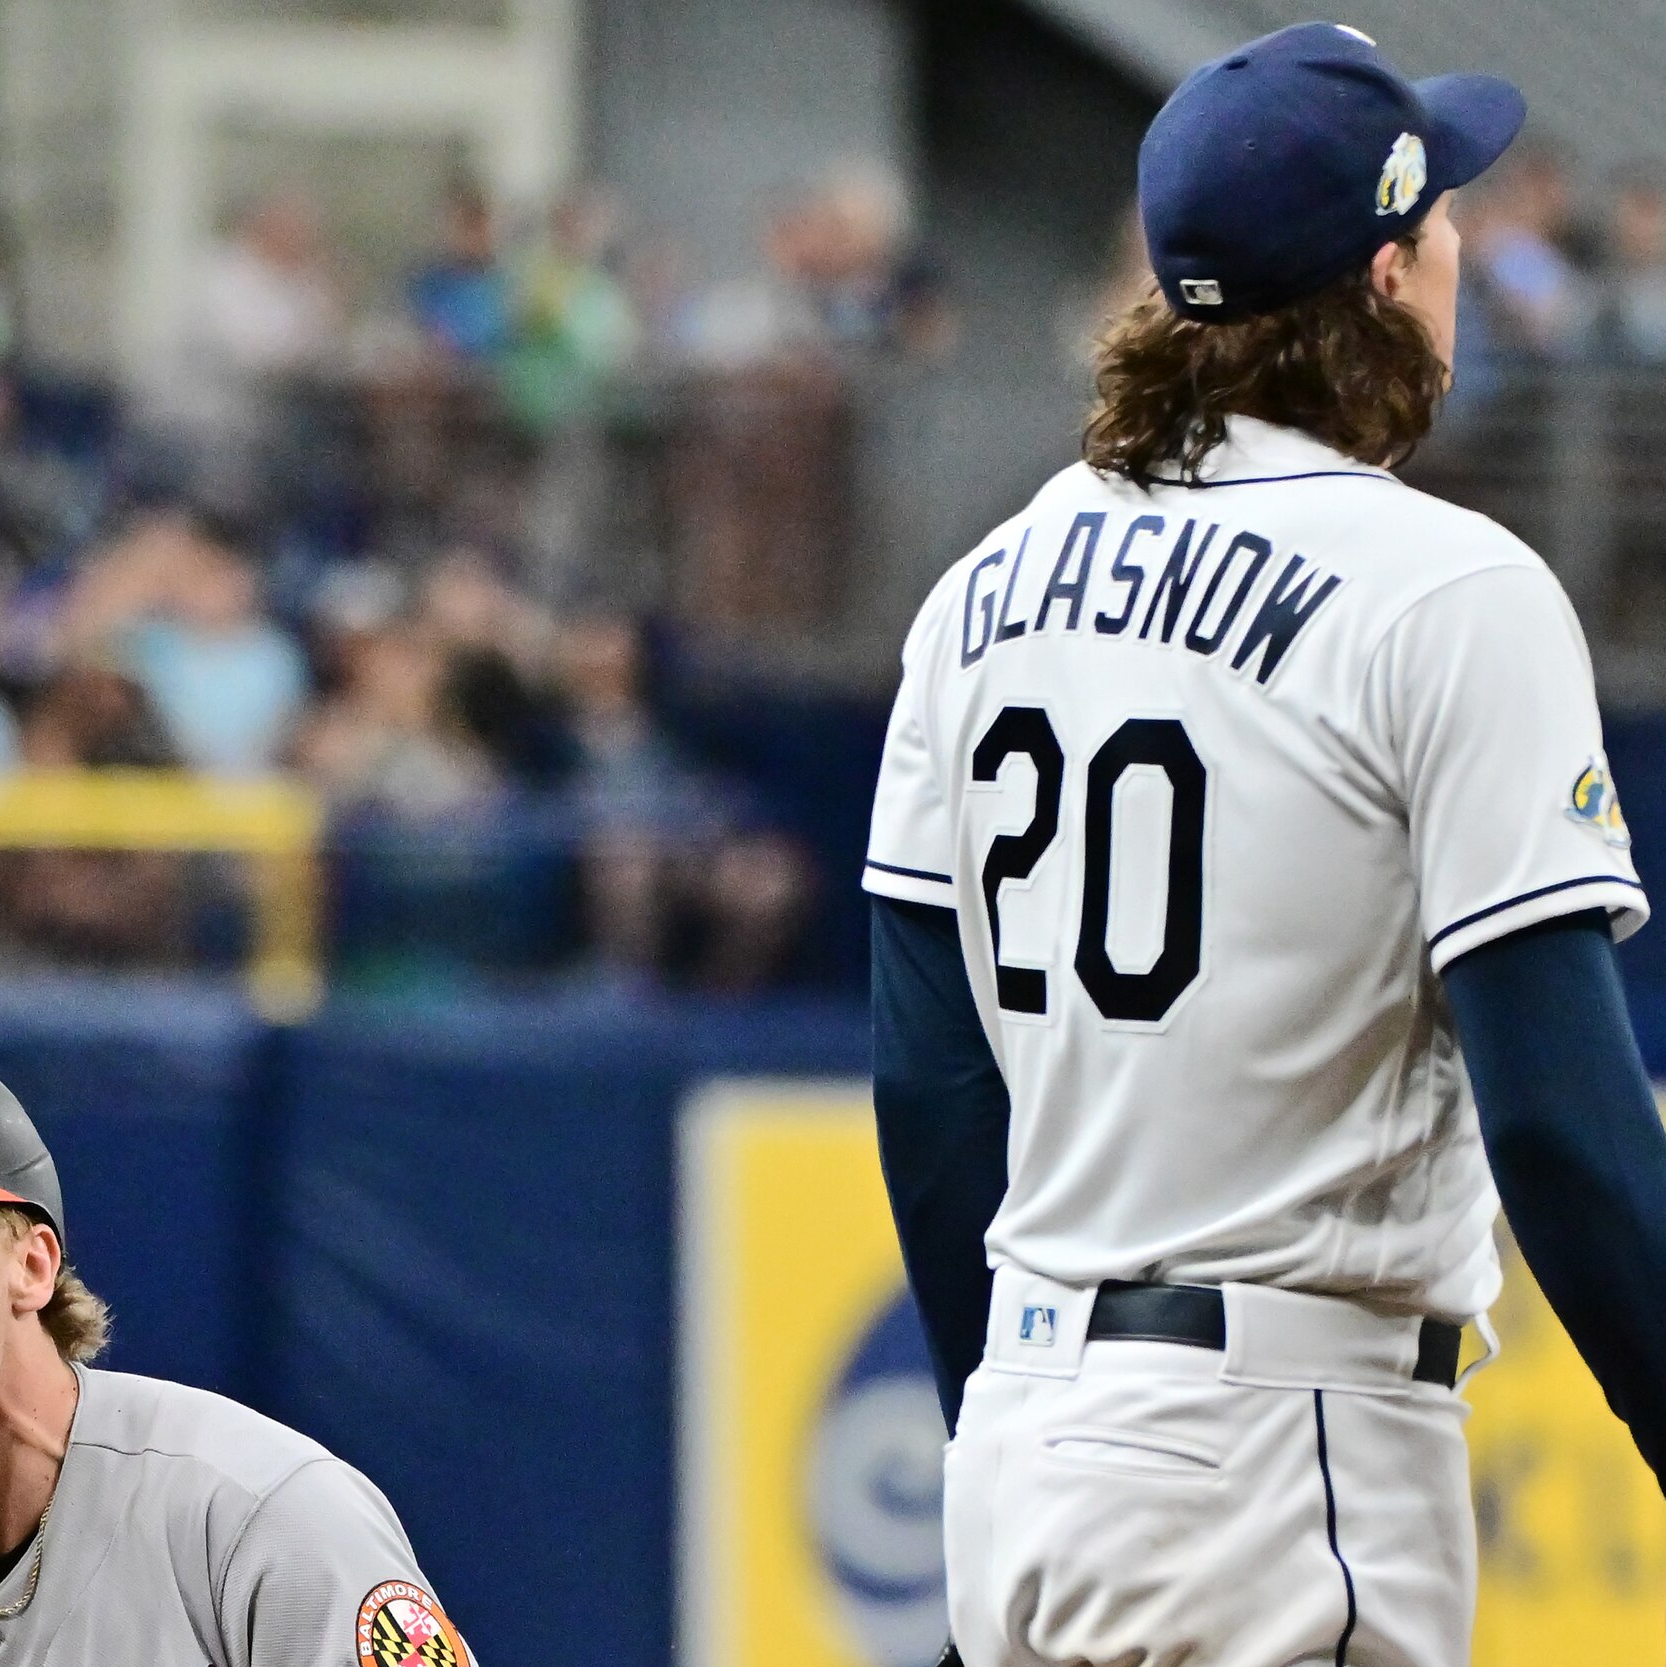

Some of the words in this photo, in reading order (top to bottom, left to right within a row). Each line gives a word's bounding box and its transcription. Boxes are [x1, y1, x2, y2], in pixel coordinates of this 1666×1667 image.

[959, 511, 1343, 686] GLASNOW
[971, 705, 1208, 1023] 20
[359, 1584, 434, 1656] BALTIMORE
